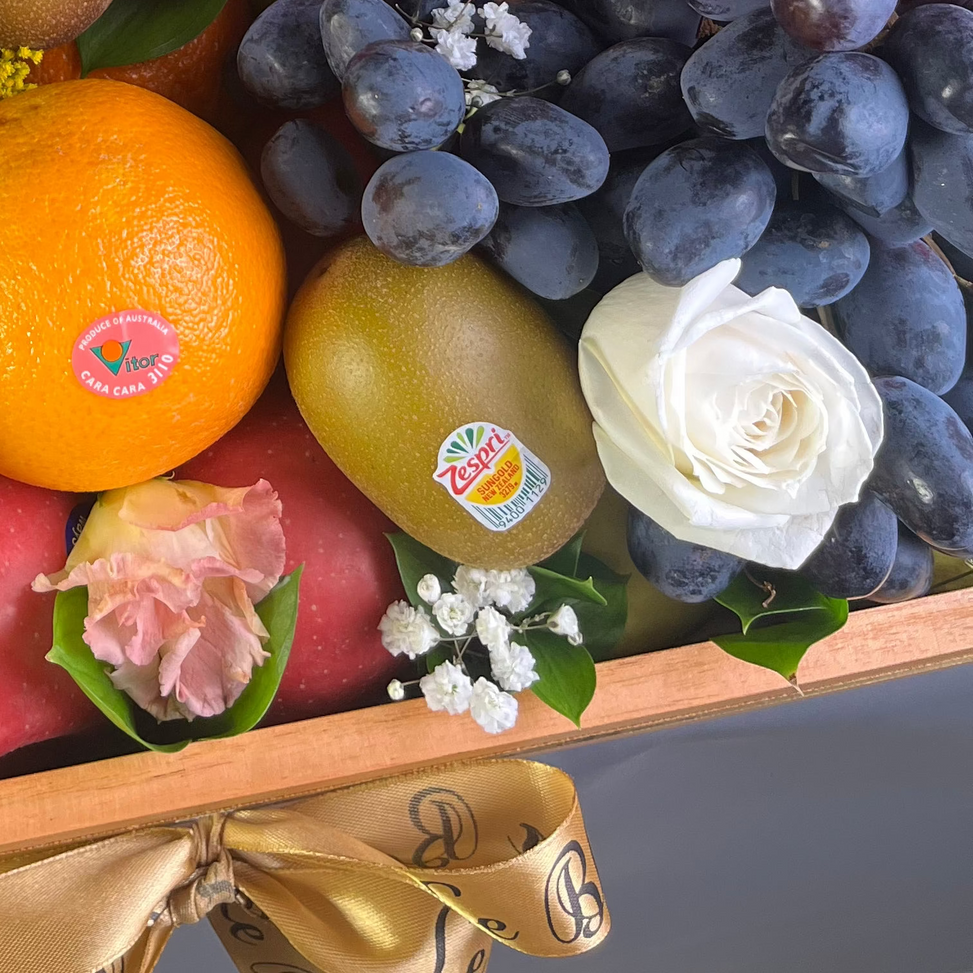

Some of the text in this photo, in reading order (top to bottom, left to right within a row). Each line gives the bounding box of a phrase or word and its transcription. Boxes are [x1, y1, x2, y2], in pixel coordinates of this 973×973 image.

[78, 314, 169, 351] PRODUCE OF AUSTRALIA
[80, 354, 174, 396] CARA CARA 3110
[437, 427, 507, 495] Zespri
[476, 460, 514, 496] SUNGOLD
[481, 463, 520, 502] NEW ZEALAND
[498, 484, 515, 499] 3279
[498, 477, 548, 529] 9400 1129
